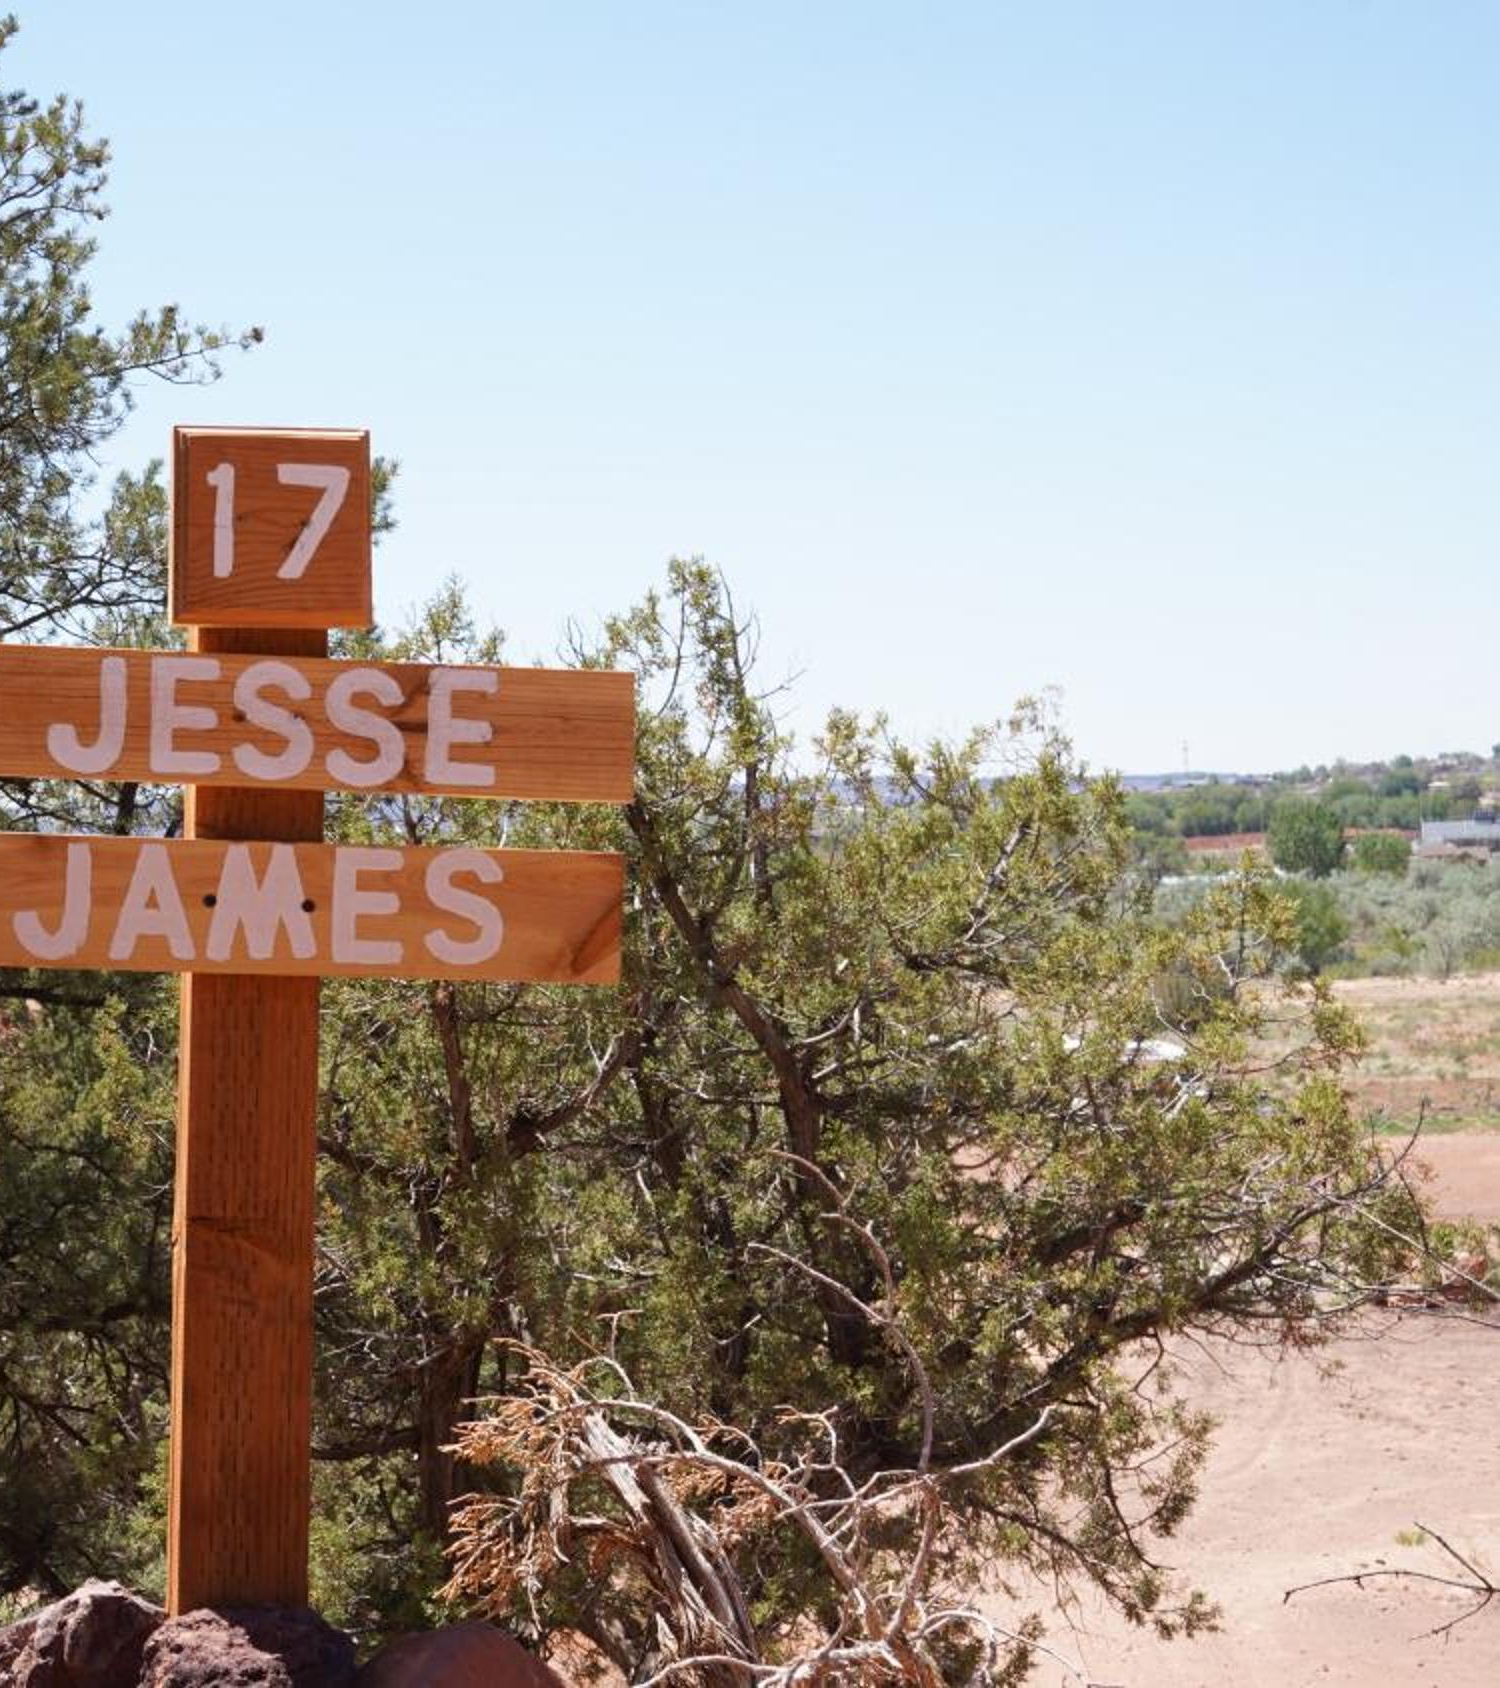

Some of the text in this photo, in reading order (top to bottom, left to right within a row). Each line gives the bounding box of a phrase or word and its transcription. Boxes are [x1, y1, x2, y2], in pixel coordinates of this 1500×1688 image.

[206, 463, 350, 579] 17
[47, 656, 499, 787] JESSE
[13, 843, 504, 964] JAMES
